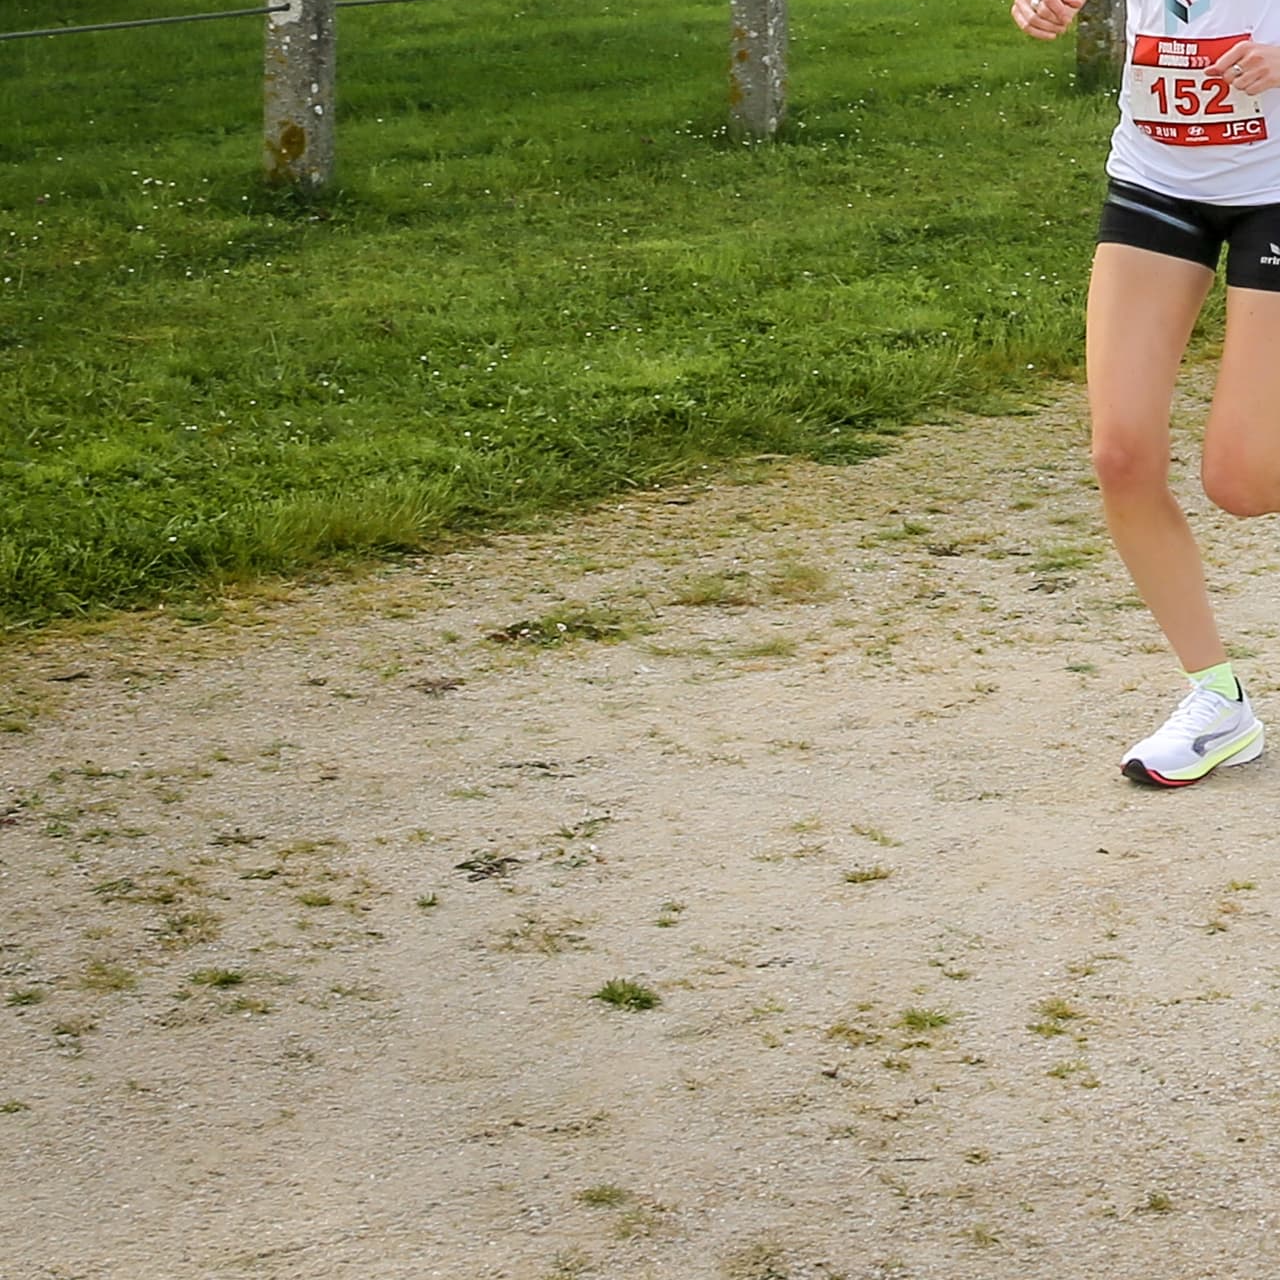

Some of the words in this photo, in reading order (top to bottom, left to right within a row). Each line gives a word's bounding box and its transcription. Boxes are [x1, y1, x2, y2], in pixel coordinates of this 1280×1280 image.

[1151, 76, 1234, 116] 152
[1155, 126, 1177, 137] RUN
[1222, 120, 1261, 138] JFC
